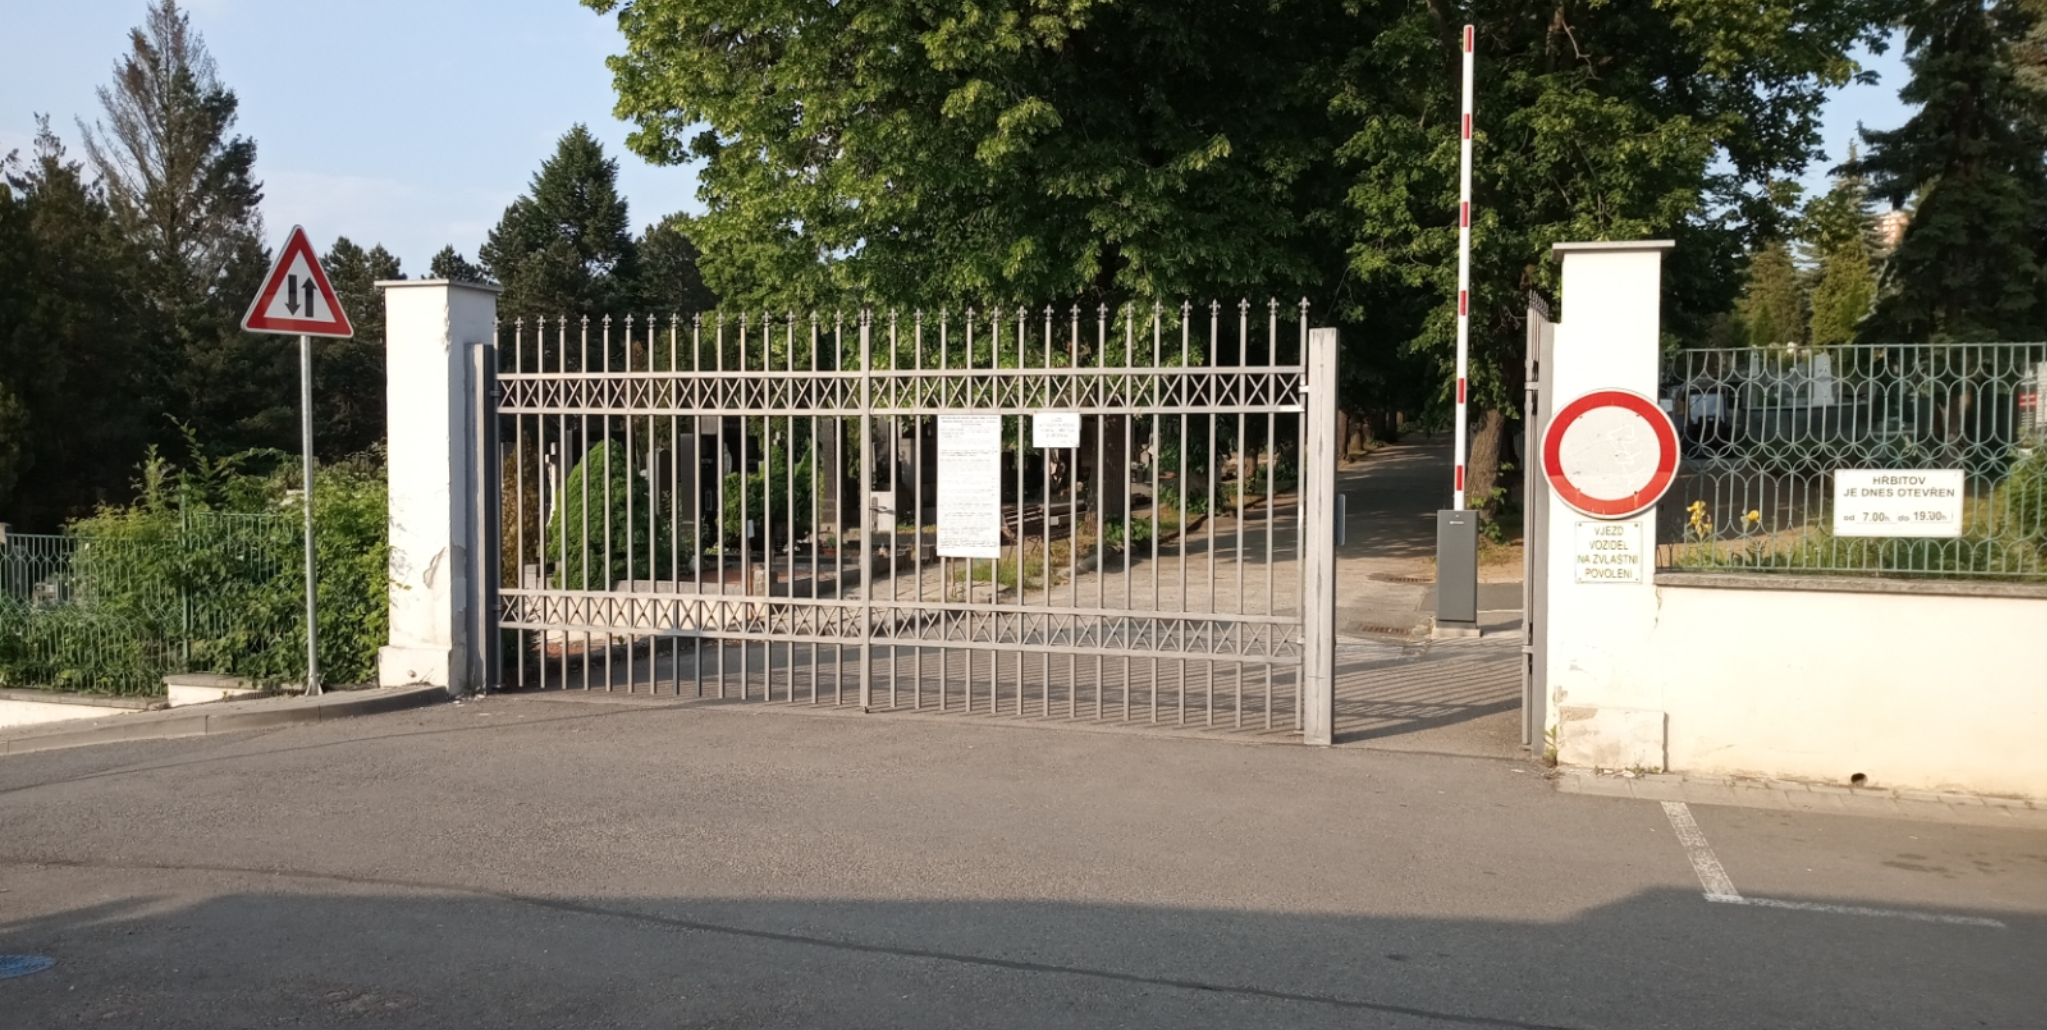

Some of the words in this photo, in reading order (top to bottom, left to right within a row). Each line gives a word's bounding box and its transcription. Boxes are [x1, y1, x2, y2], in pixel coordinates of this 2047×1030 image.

[1872, 474, 1926, 485] HŘBITOV
[1843, 488, 1858, 497] JE
[1861, 488, 1894, 497] DNES
[1897, 486, 1955, 497] OTEVŘEN
[1594, 525, 1624, 536] VJEZD
[1589, 539, 1629, 550] VOZIDEL
[1577, 554, 1590, 564] NA
